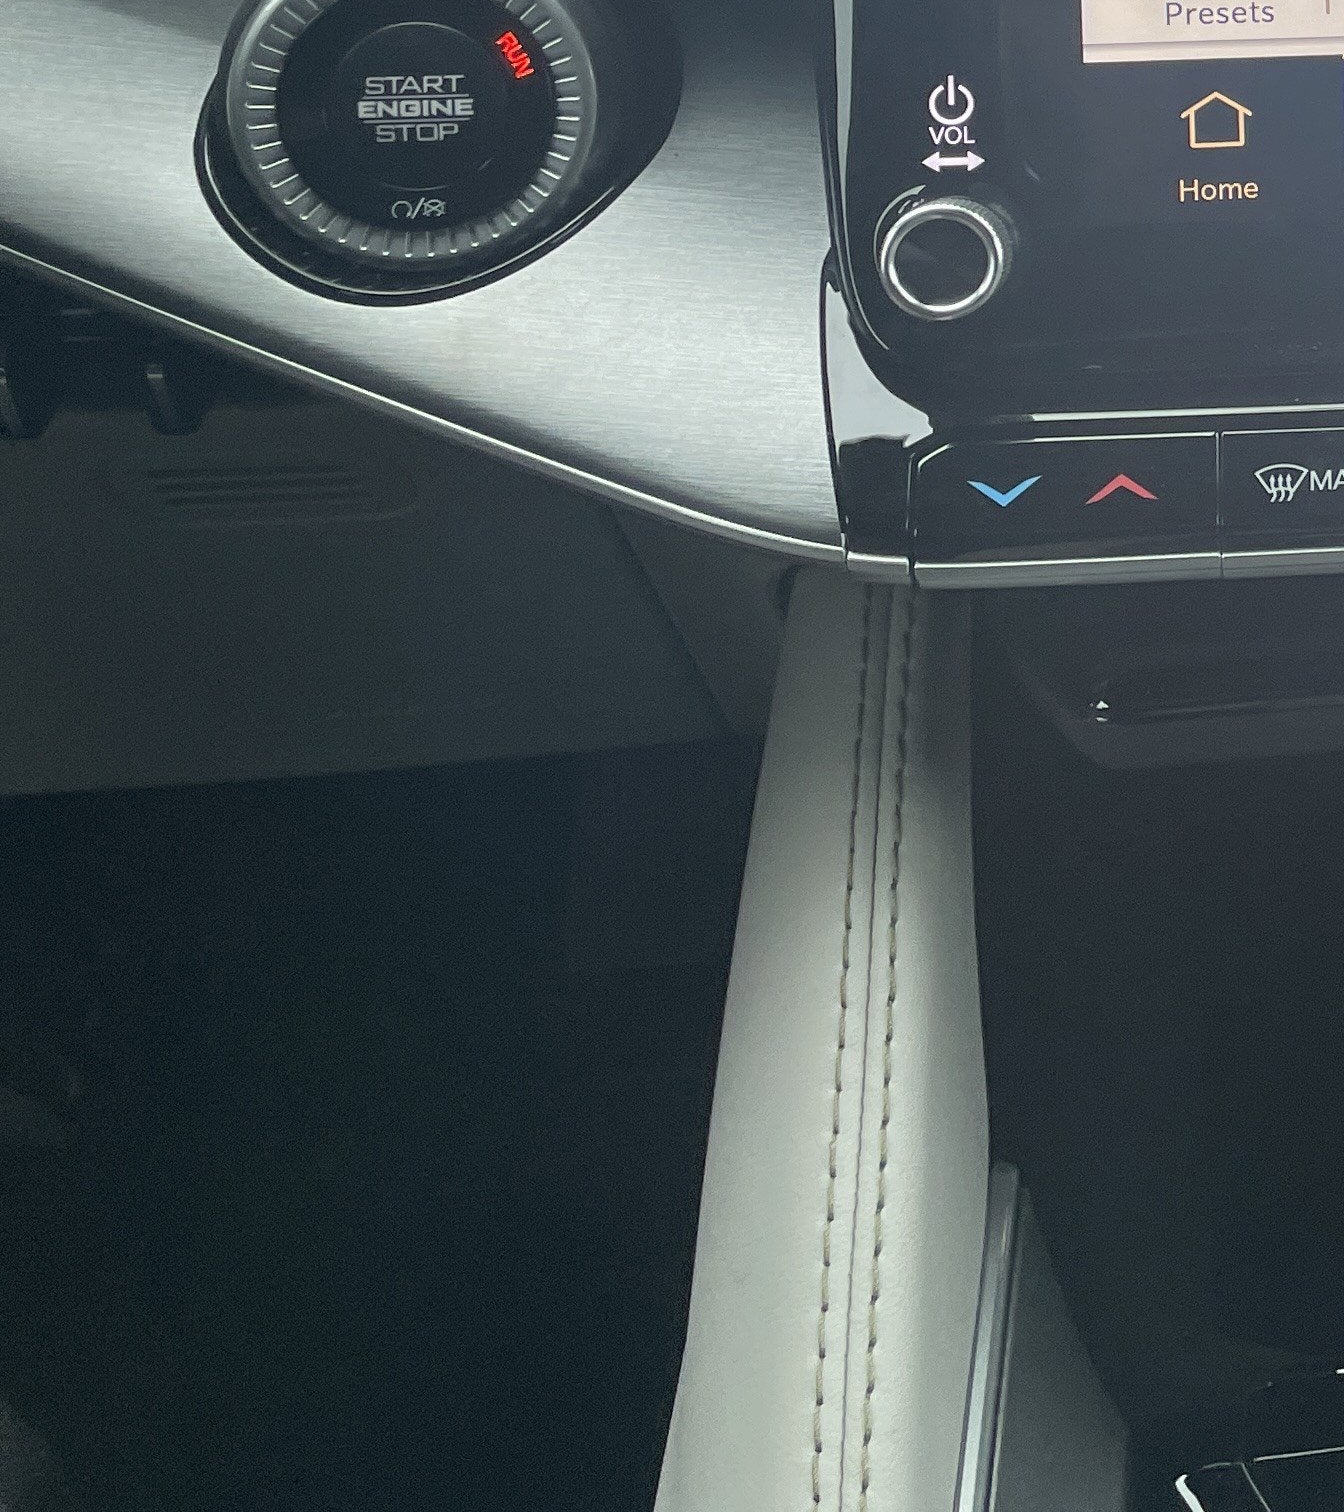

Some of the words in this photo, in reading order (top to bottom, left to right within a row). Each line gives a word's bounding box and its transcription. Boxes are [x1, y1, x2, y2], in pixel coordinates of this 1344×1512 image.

[1164, 1, 1275, 27] Presets
[494, 31, 535, 79] RUN
[364, 74, 466, 95] START
[356, 98, 475, 119] ENGINE
[375, 122, 460, 143] STOP
[928, 125, 976, 145] VOL
[1179, 179, 1259, 203] Home
